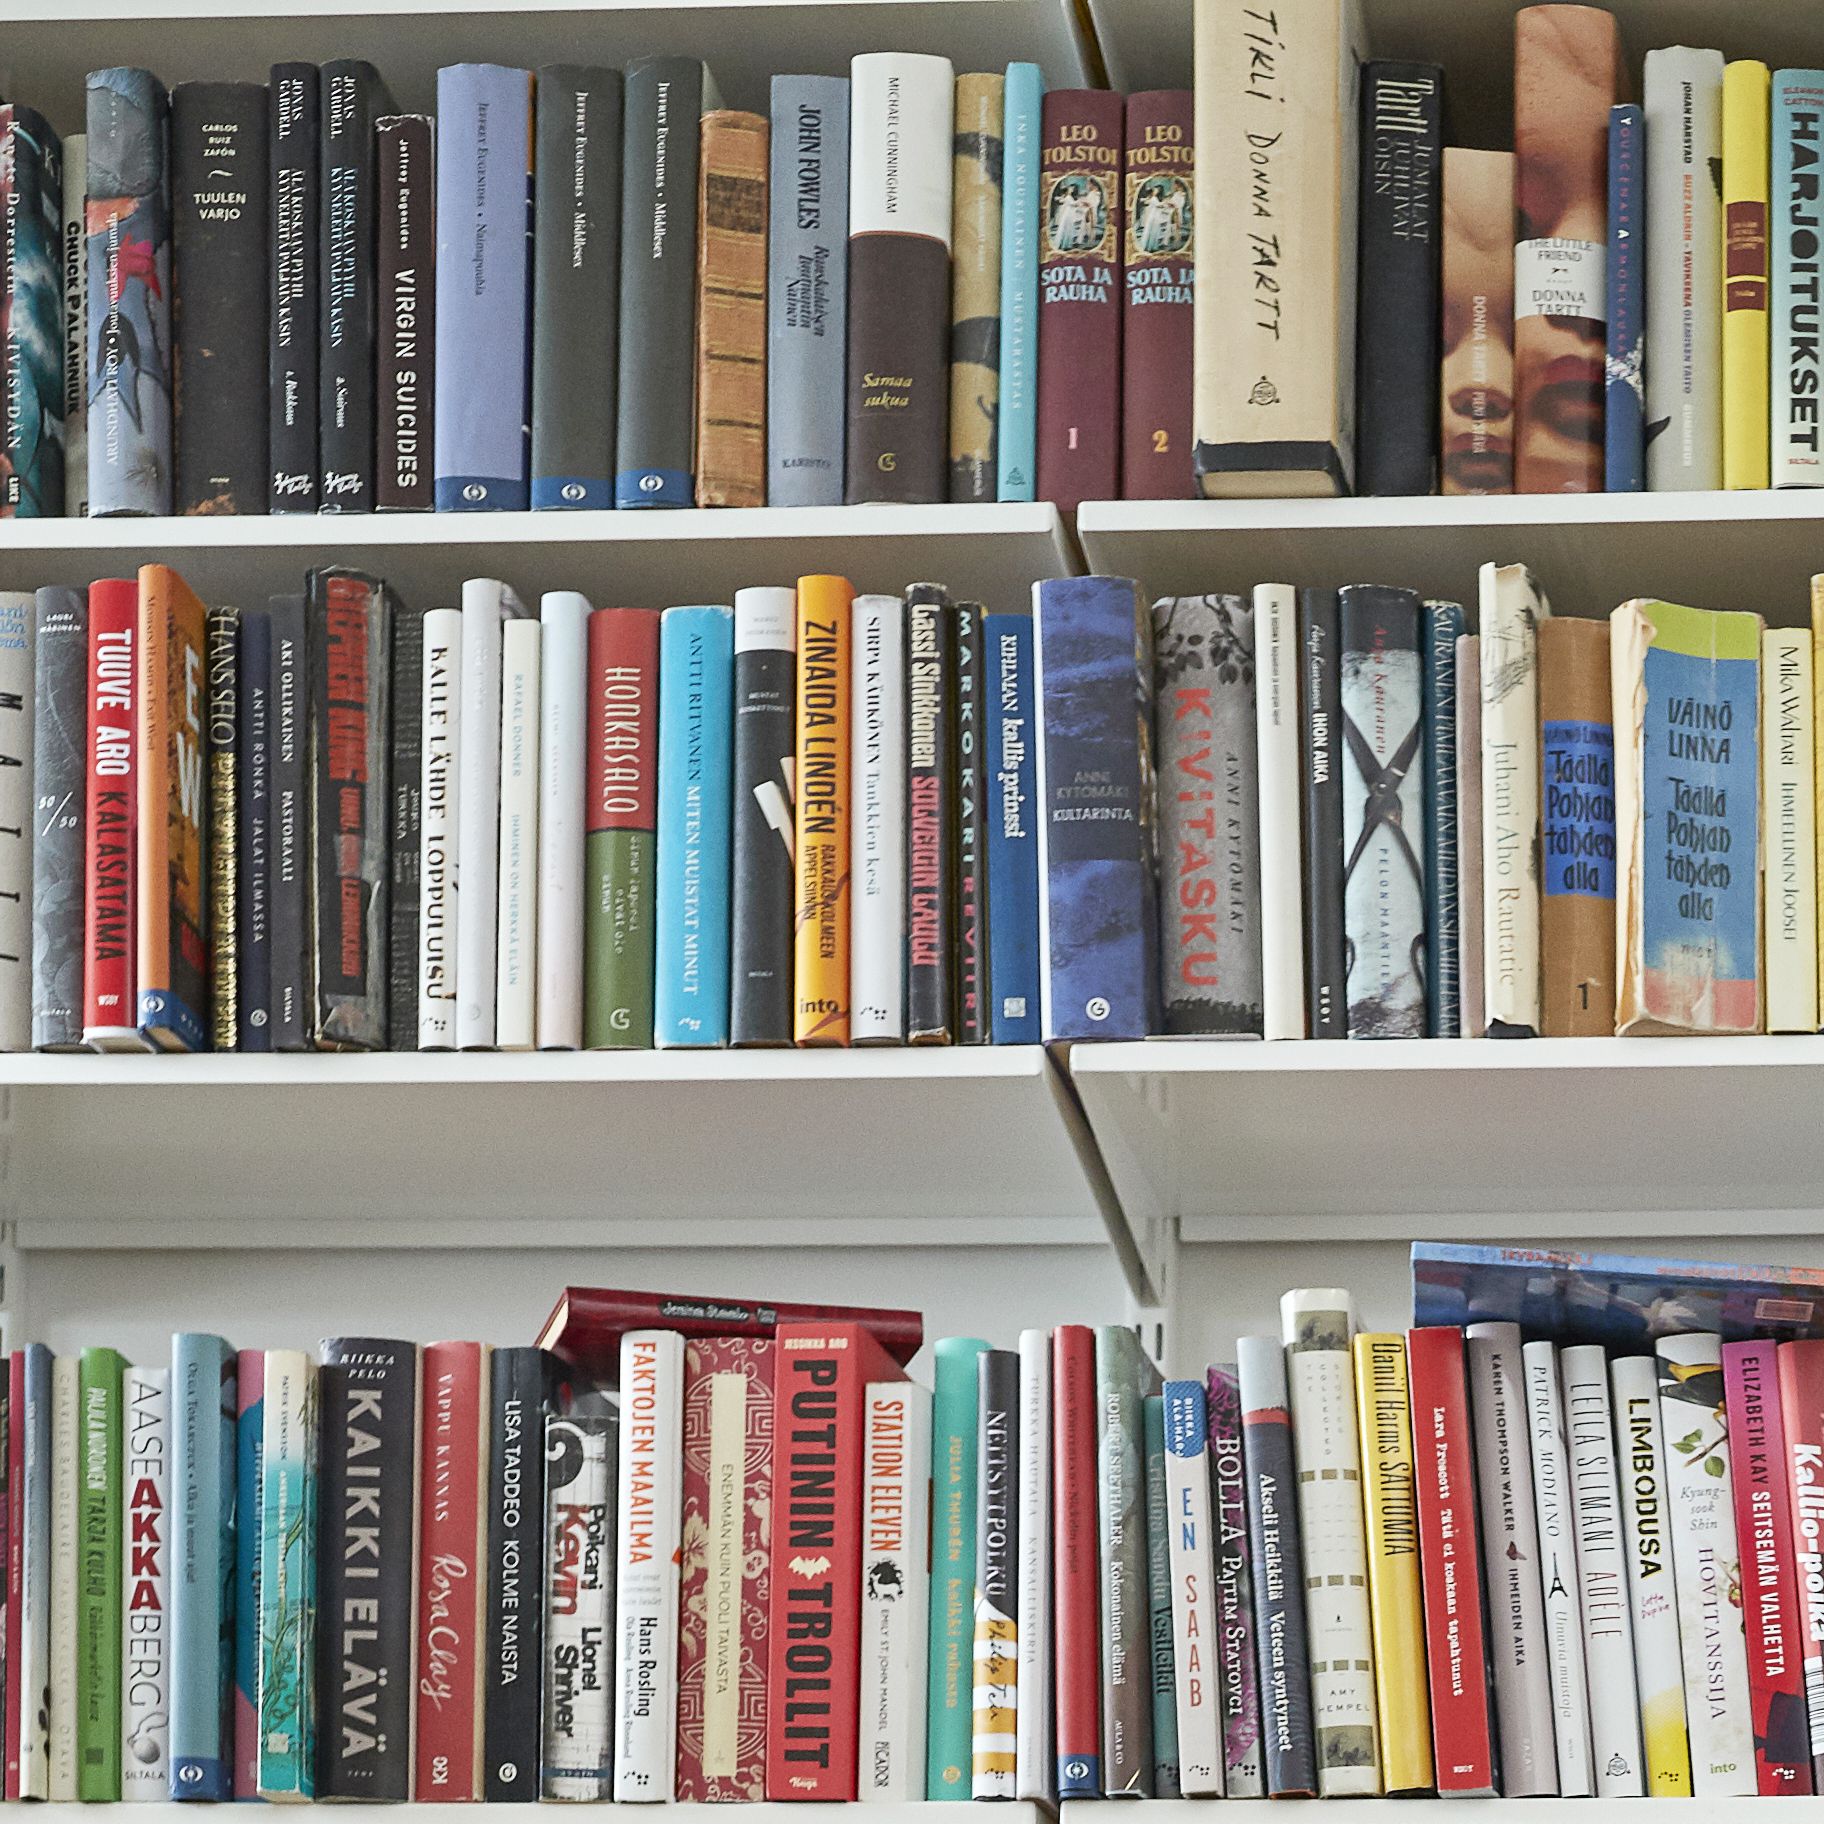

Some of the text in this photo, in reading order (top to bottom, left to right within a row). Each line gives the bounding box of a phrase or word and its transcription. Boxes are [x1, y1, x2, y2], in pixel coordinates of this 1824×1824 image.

[798, 105, 821, 229] JOHN FOWLES
[1044, 145, 1117, 164] TOLSTOI
[1060, 126, 1098, 143] LEO
[193, 192, 246, 206] TUULEN
[199, 206, 241, 220] VARJO
[66, 222, 82, 415] CHUCK PALAHNIUK
[395, 268, 415, 358] VIRGIN
[1042, 266, 1113, 285] SOTA JA
[1046, 284, 1107, 302] RAUHA
[1789, 114, 1820, 453] HARJOITUKSET
[395, 371, 418, 488] SUICIDES
[281, 640, 294, 882] AKI OLLIKAINEN PASTORAALI
[603, 667, 640, 813] HONKASALO
[1312, 712, 1329, 784] IHON AIKA
[1668, 699, 1733, 729] VÄINÖ
[1669, 732, 1730, 764] LINNA
[94, 629, 131, 962] TUUVE ARO KALASATAMA
[1175, 688, 1218, 986] KIVITASKU
[1667, 813, 1731, 854] Pohjan
[1672, 779, 1726, 818] Täällä
[1488, 741, 1523, 986] Juhani Aho Rautatie
[1665, 853, 1730, 890] tähden
[1679, 890, 1714, 923] alla
[800, 998, 838, 1015] into
[629, 1342, 657, 1564] FAKTOJEN MAAILMA
[870, 1401, 904, 1551] STATION ELEVEN
[1216, 1436, 1245, 1545] BOLLA
[1629, 1398, 1661, 1580] LIMBODUSA
[343, 1390, 388, 1758] KAIKKI ELÄVÄ
[501, 1400, 522, 1685] LISA TADDEO KOLME NAISTA
[784, 1359, 836, 1769] PUTININ TROLLIT
[1742, 1358, 1785, 1677] ELIZABETH KAY SEITSEMÄN VALHETTA
